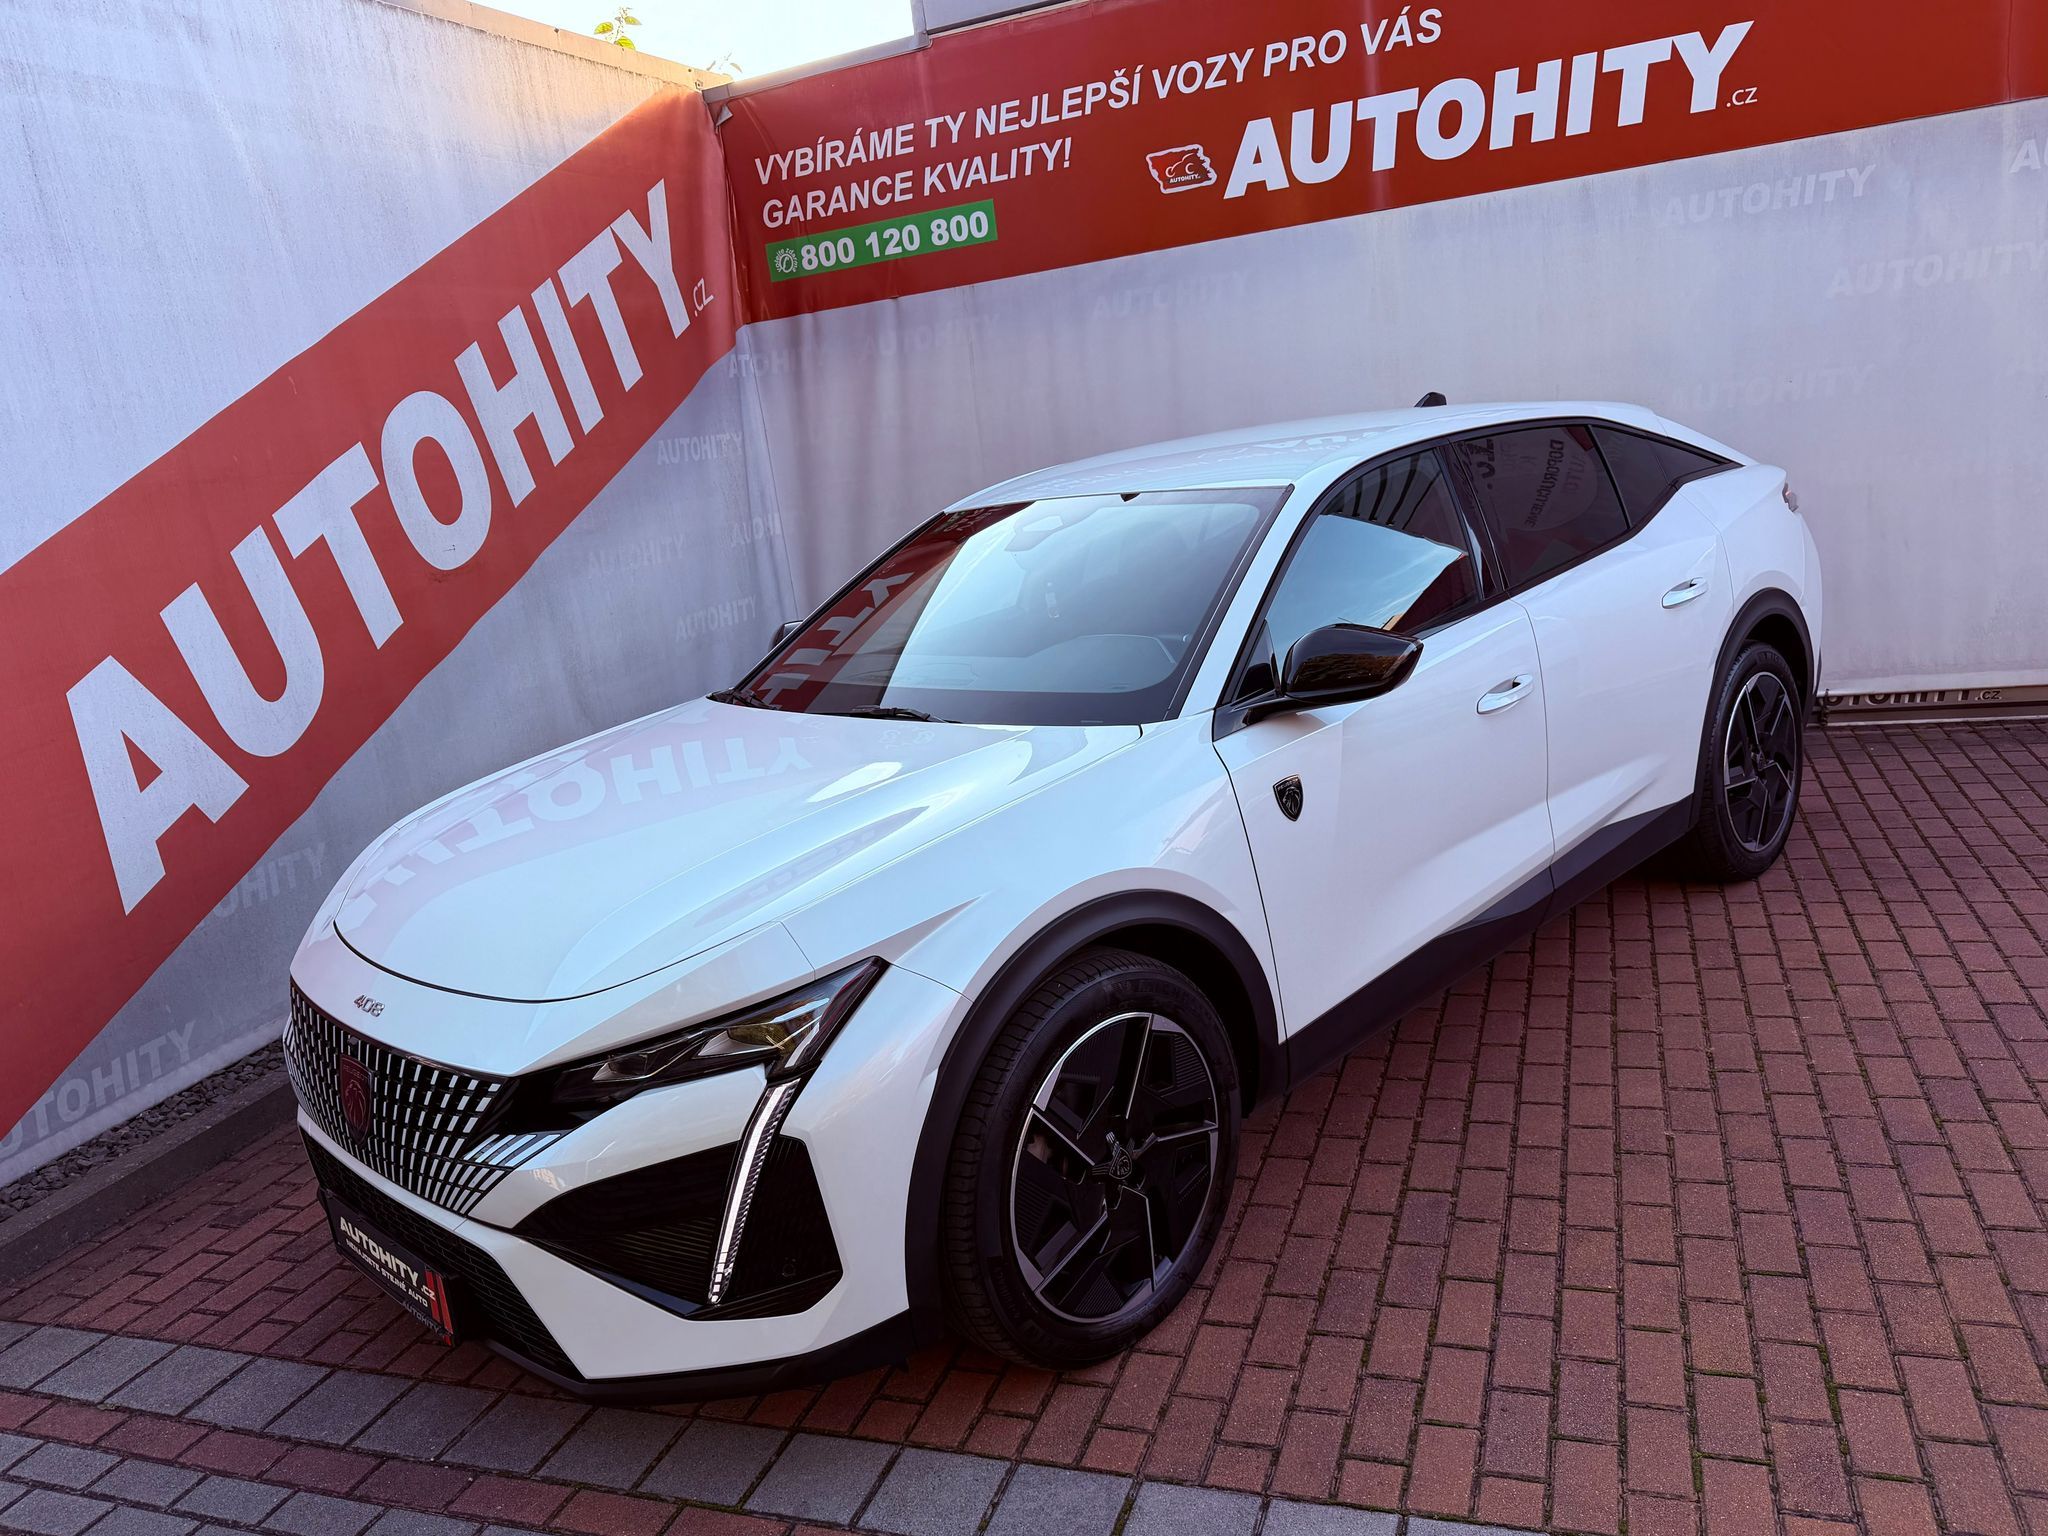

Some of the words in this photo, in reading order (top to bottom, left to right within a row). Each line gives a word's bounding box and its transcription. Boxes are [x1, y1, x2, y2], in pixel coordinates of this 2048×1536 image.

[754, 123, 915, 186] VYBÍRÁME
[925, 111, 967, 149] TY
[975, 64, 1144, 139] NEJLEPŠÍ
[1152, 48, 1256, 100] VOZY
[1263, 29, 1348, 77] PRO
[1360, 6, 1443, 56] VÁS
[1223, 20, 1755, 199] AUTOHITY
[763, 170, 914, 229] GARANCE
[923, 136, 1073, 197] KVALITY!
[800, 236, 856, 271] 800
[865, 223, 921, 258] 120
[930, 210, 989, 246] 800
[66, 178, 691, 916] AUTOHITY
[353, 994, 386, 1018] 408
[340, 1216, 419, 1287] AUTOHITY
